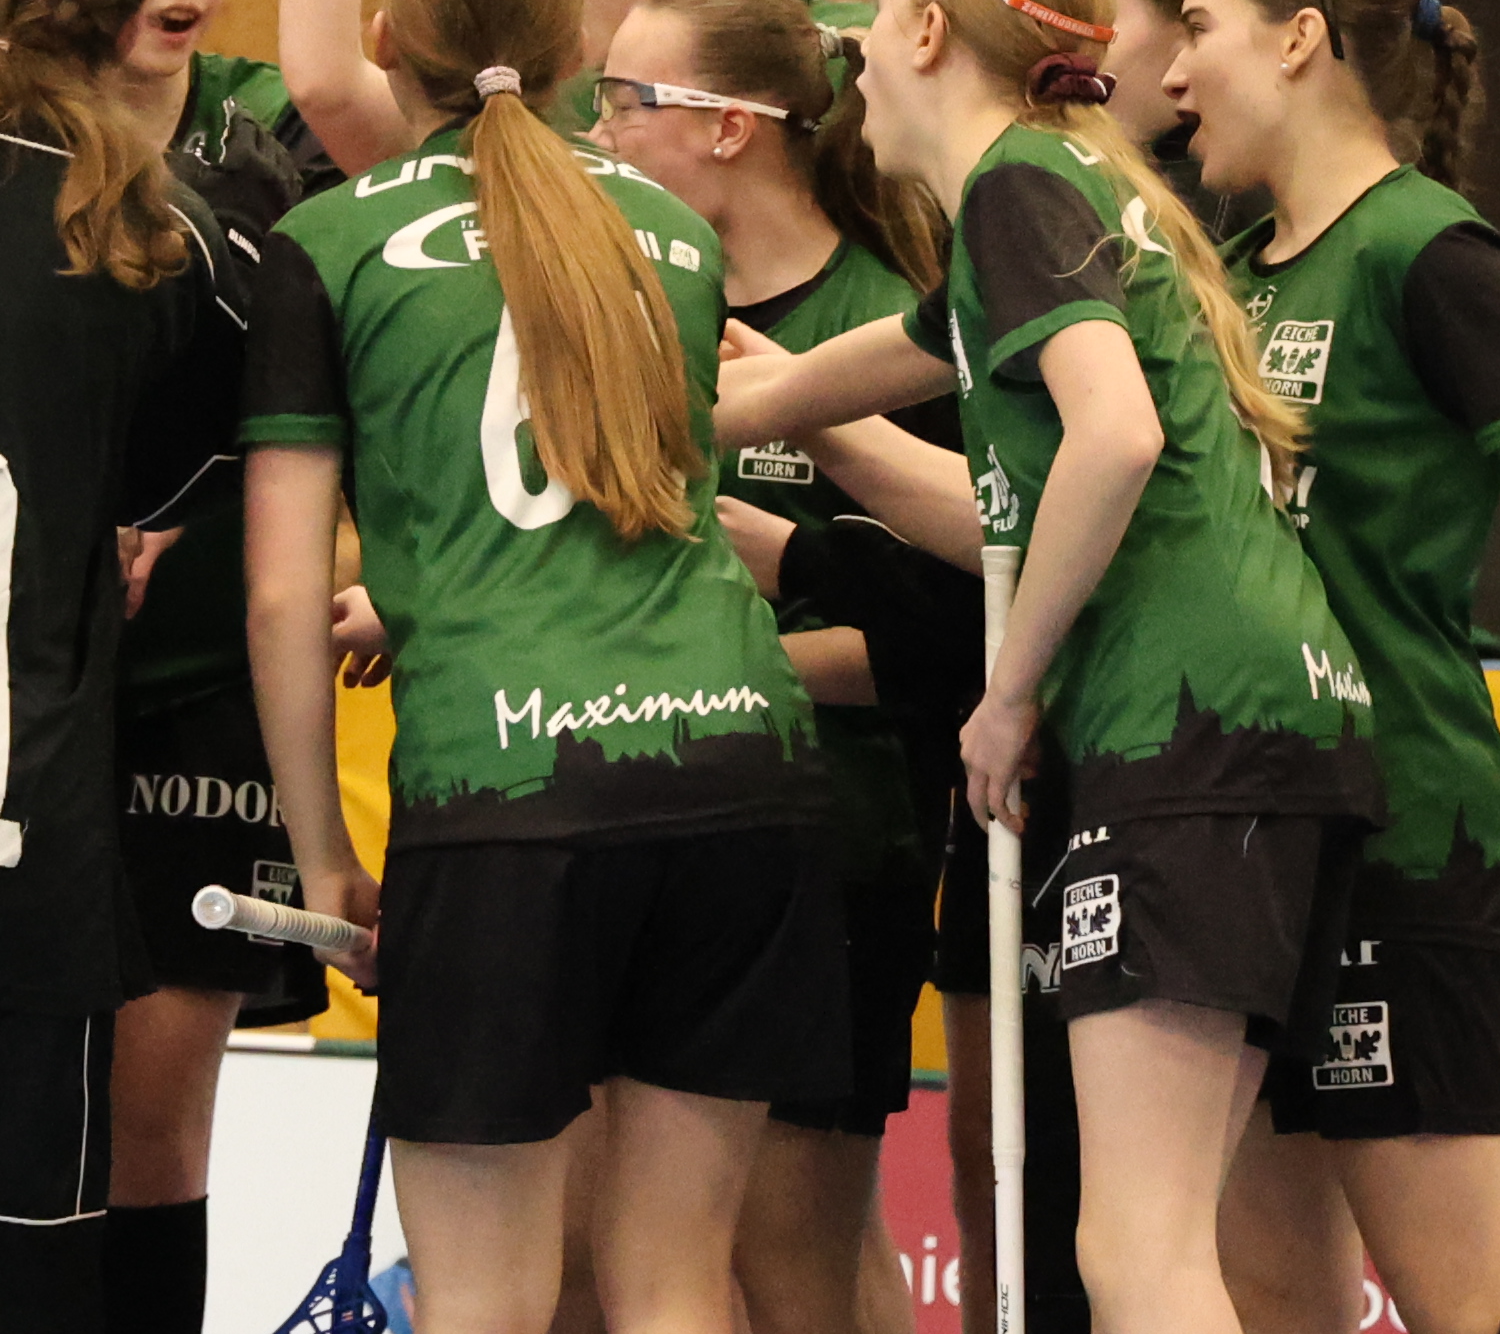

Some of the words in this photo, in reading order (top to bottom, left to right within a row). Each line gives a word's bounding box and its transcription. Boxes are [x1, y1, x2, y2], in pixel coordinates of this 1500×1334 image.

[1280, 324, 1322, 342] EICHE
[752, 459, 797, 479] HORN
[494, 683, 770, 750] Maximum
[1069, 882, 1104, 905] EICHE
[1070, 939, 1107, 962] HORN
[1329, 1068, 1374, 1084] HORN
